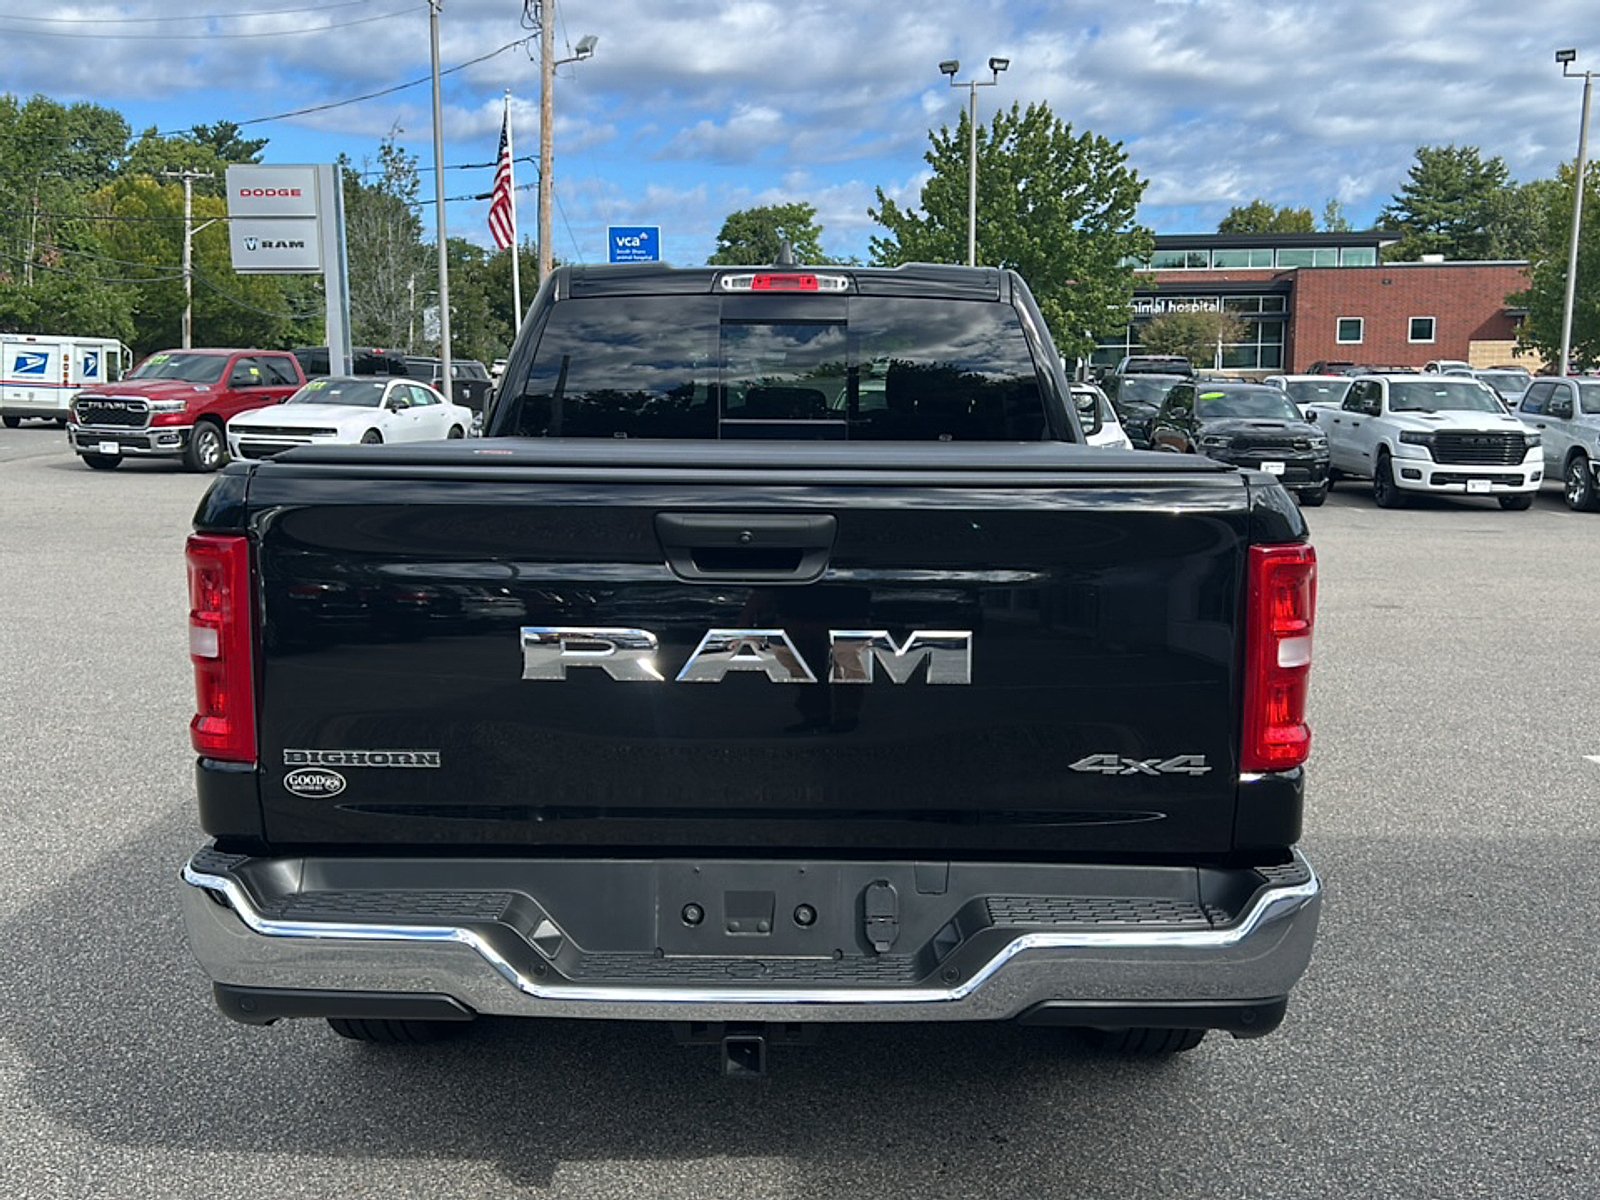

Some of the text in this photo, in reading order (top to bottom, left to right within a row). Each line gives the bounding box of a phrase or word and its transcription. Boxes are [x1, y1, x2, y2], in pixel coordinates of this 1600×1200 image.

[239, 188, 302, 197] DODGE
[261, 240, 305, 249] RAM
[615, 236, 641, 247] vca
[1123, 297, 1220, 314] nimal hospital
[520, 626, 973, 684] RAM
[283, 748, 441, 769] BIGHORN
